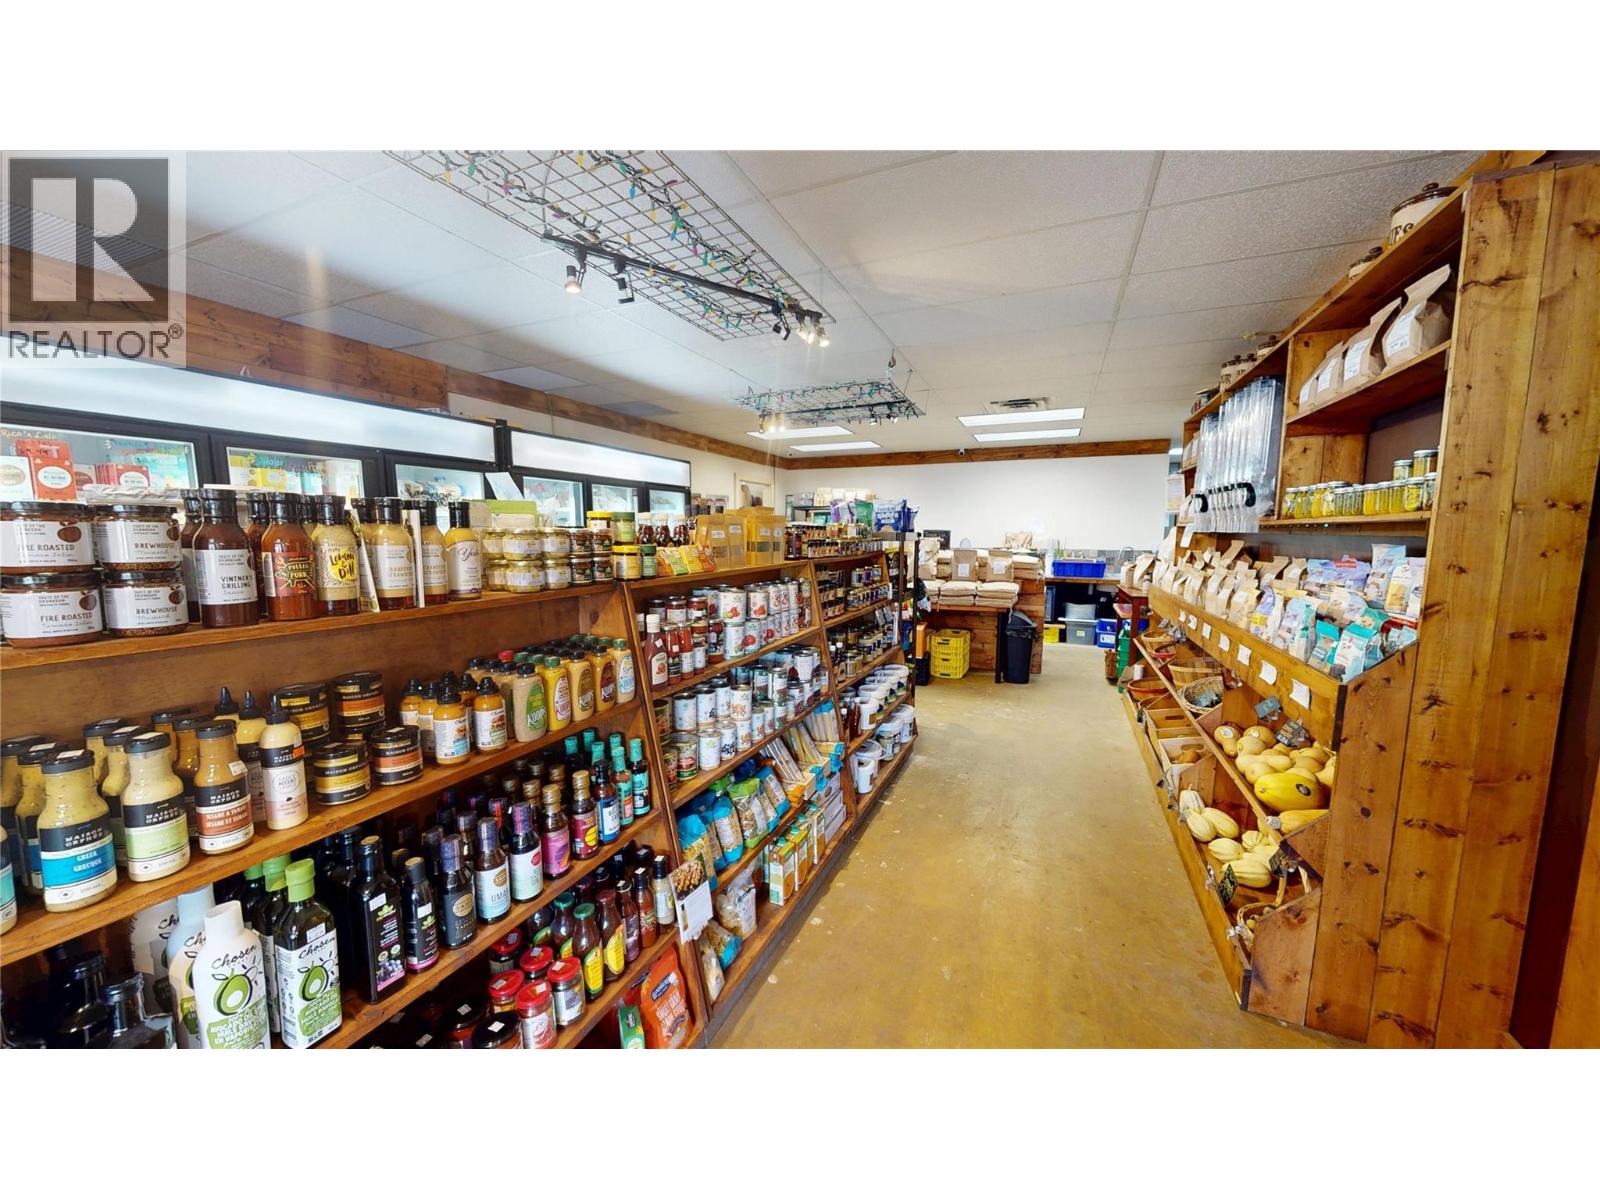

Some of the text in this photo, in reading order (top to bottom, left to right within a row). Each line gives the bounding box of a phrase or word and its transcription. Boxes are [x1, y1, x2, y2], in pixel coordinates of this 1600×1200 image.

[338, 561, 355, 580] Dill
[61, 612, 93, 621] ROASTED
[135, 606, 177, 615] BREWHOUSE
[210, 790, 240, 800] MAISON
[145, 807, 179, 820] MAISON
[64, 828, 103, 842] MAISON
[76, 850, 98, 861] GREEK
[298, 936, 337, 959] Chosen
[211, 944, 257, 970] Chosen
